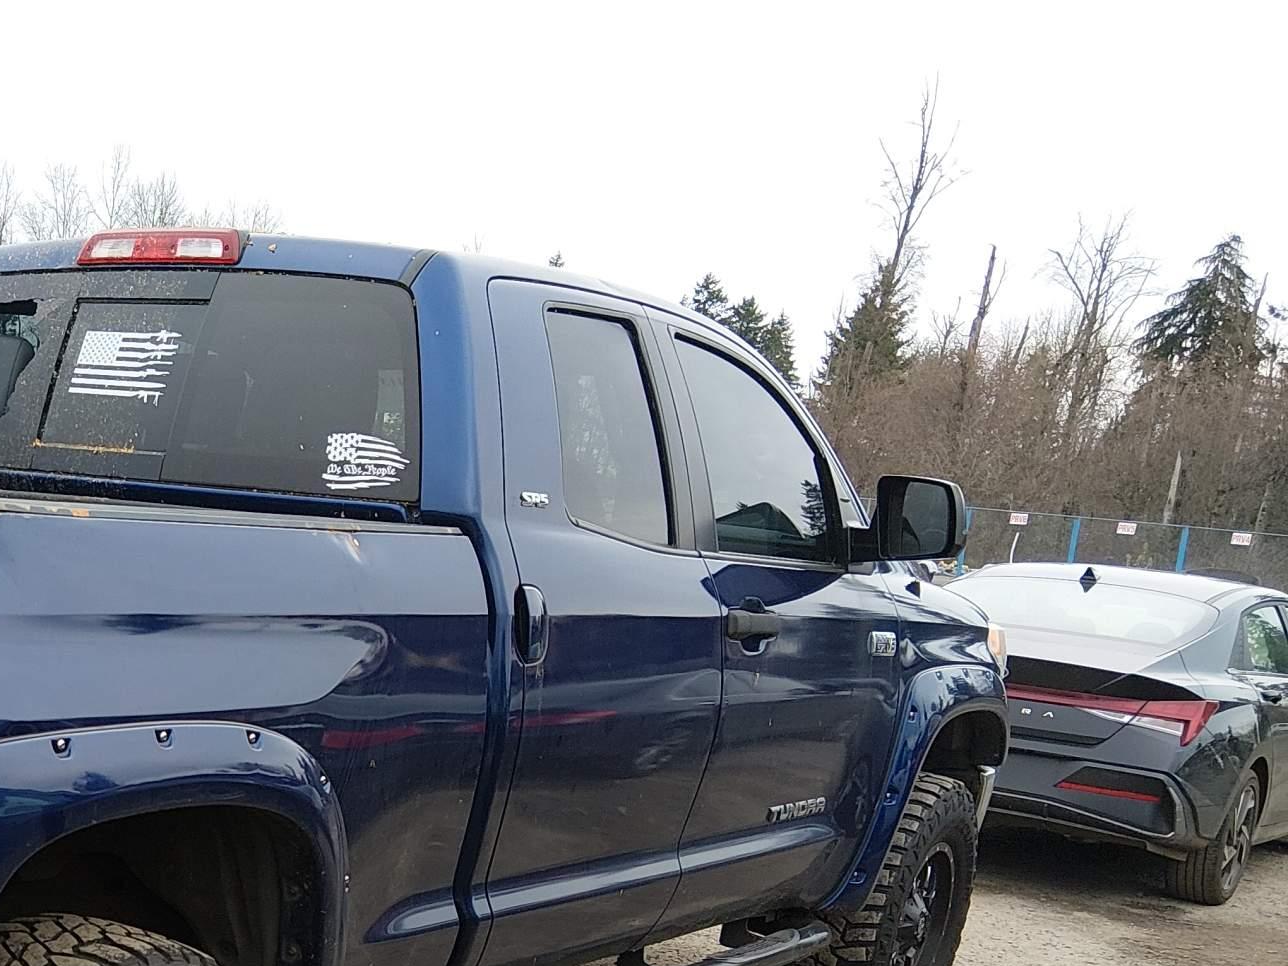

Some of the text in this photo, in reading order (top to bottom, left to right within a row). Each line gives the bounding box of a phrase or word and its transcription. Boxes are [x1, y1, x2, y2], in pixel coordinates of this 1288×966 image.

[327, 464, 342, 474] We
[361, 464, 397, 477] People
[520, 491, 549, 505] SR5
[767, 797, 826, 824] TUNDRA
